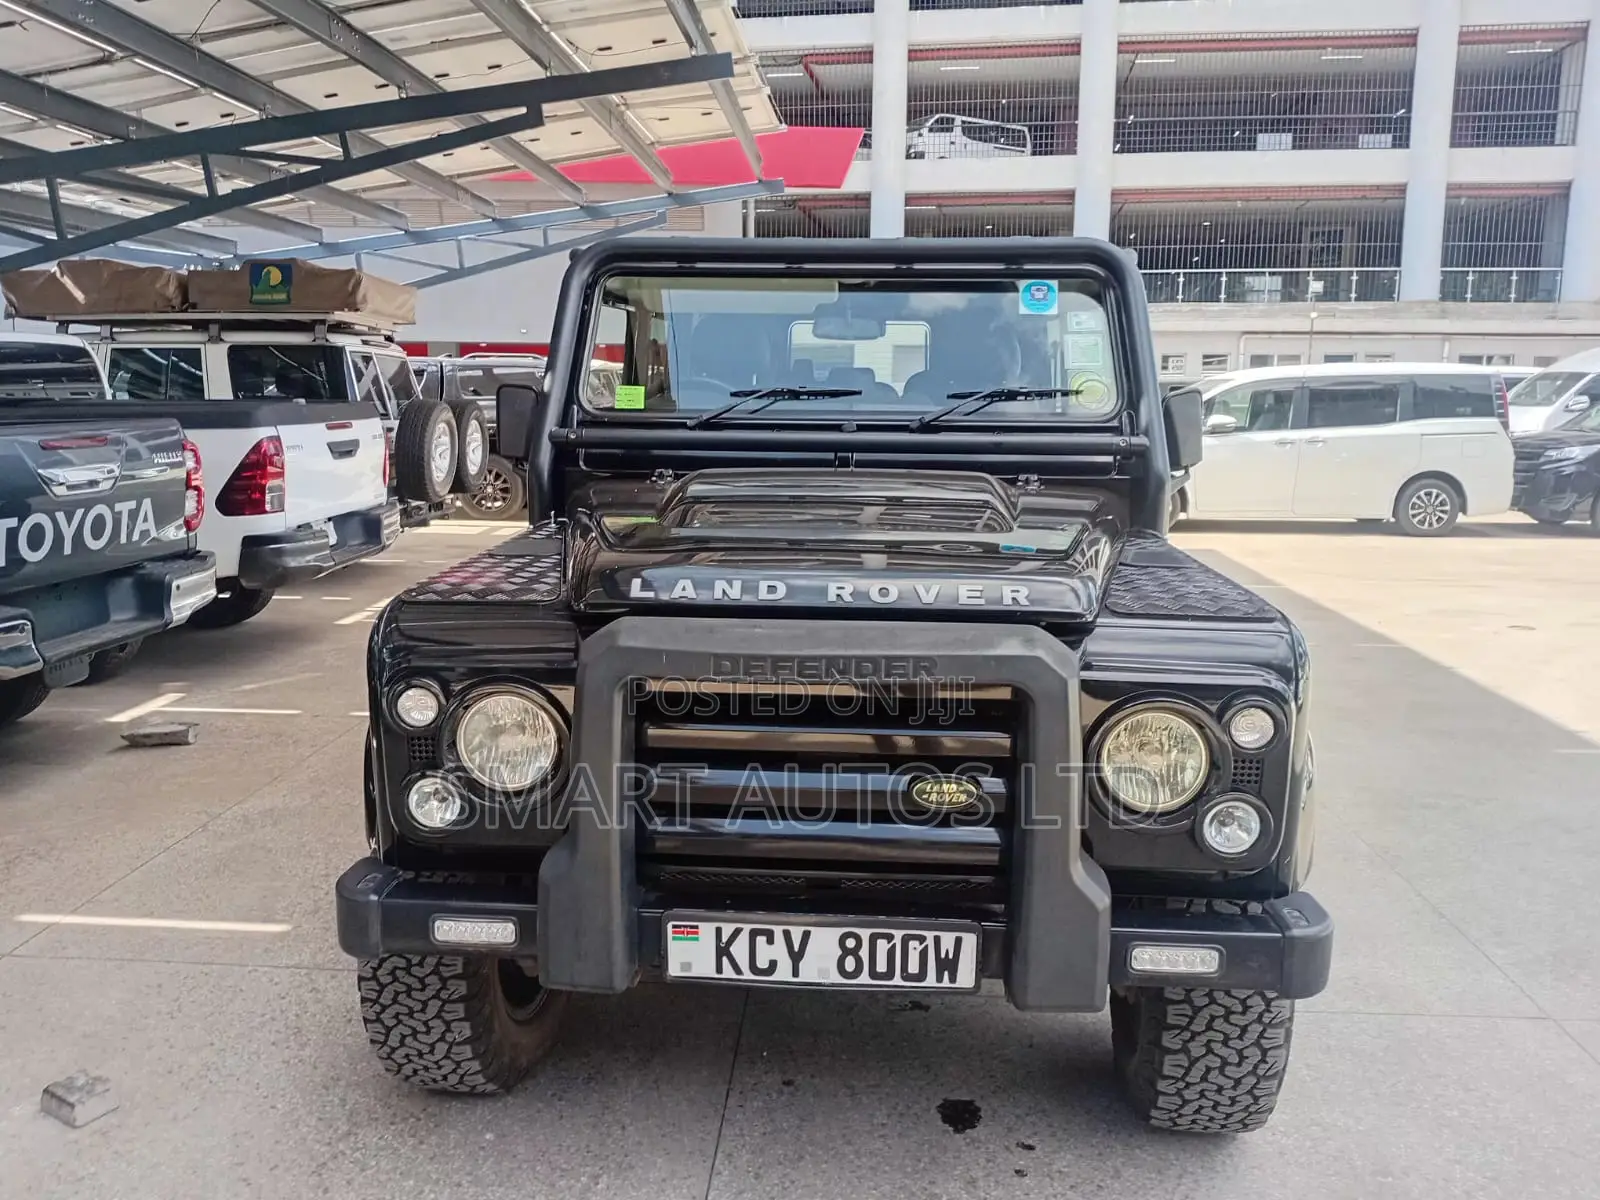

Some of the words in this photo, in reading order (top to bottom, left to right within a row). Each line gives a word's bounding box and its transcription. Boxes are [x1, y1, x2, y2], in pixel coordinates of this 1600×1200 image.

[0, 498, 158, 568] TOYOTA
[629, 577, 787, 600] LAND
[827, 581, 1031, 607] ROVER
[711, 655, 938, 681] DEFENDER
[715, 926, 811, 978] KCY
[836, 931, 973, 984] 800W
